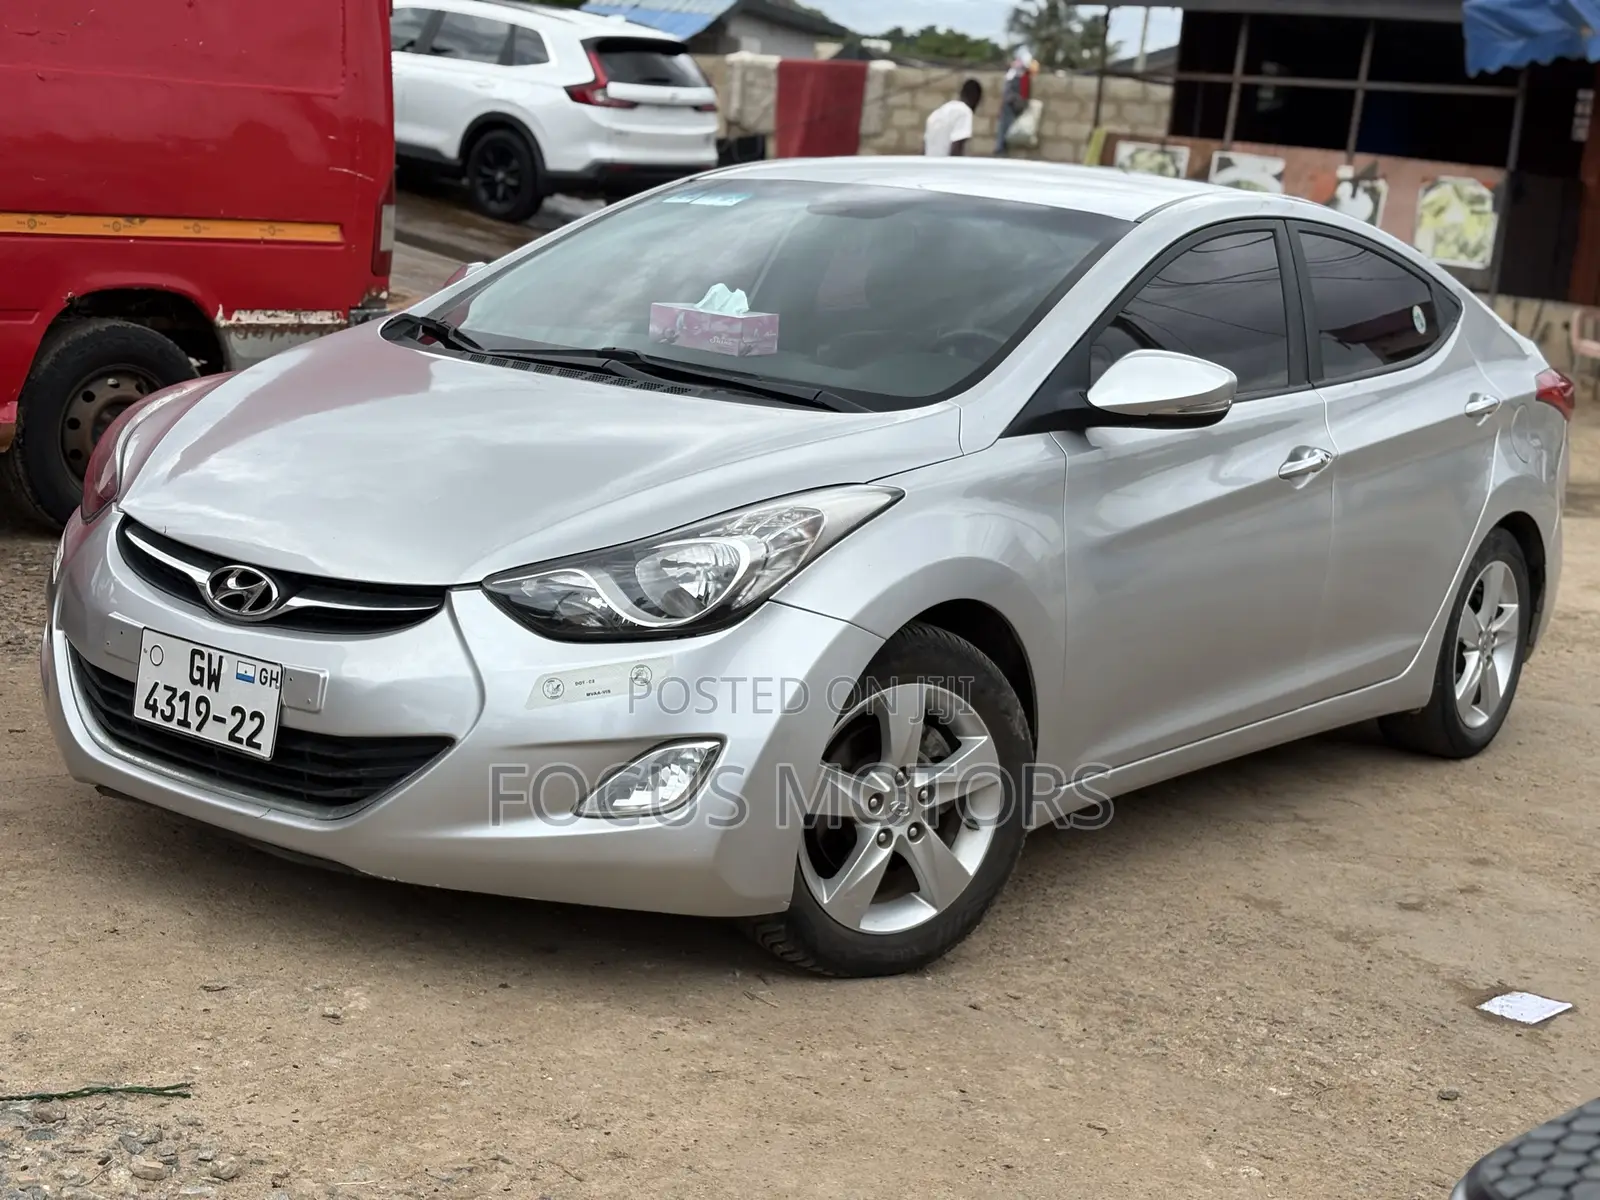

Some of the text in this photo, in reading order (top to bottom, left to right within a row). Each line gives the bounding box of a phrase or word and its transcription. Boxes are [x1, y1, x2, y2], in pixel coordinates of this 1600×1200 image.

[188, 648, 224, 693] GW
[259, 668, 280, 690] GH
[144, 681, 266, 751] 4319-22
